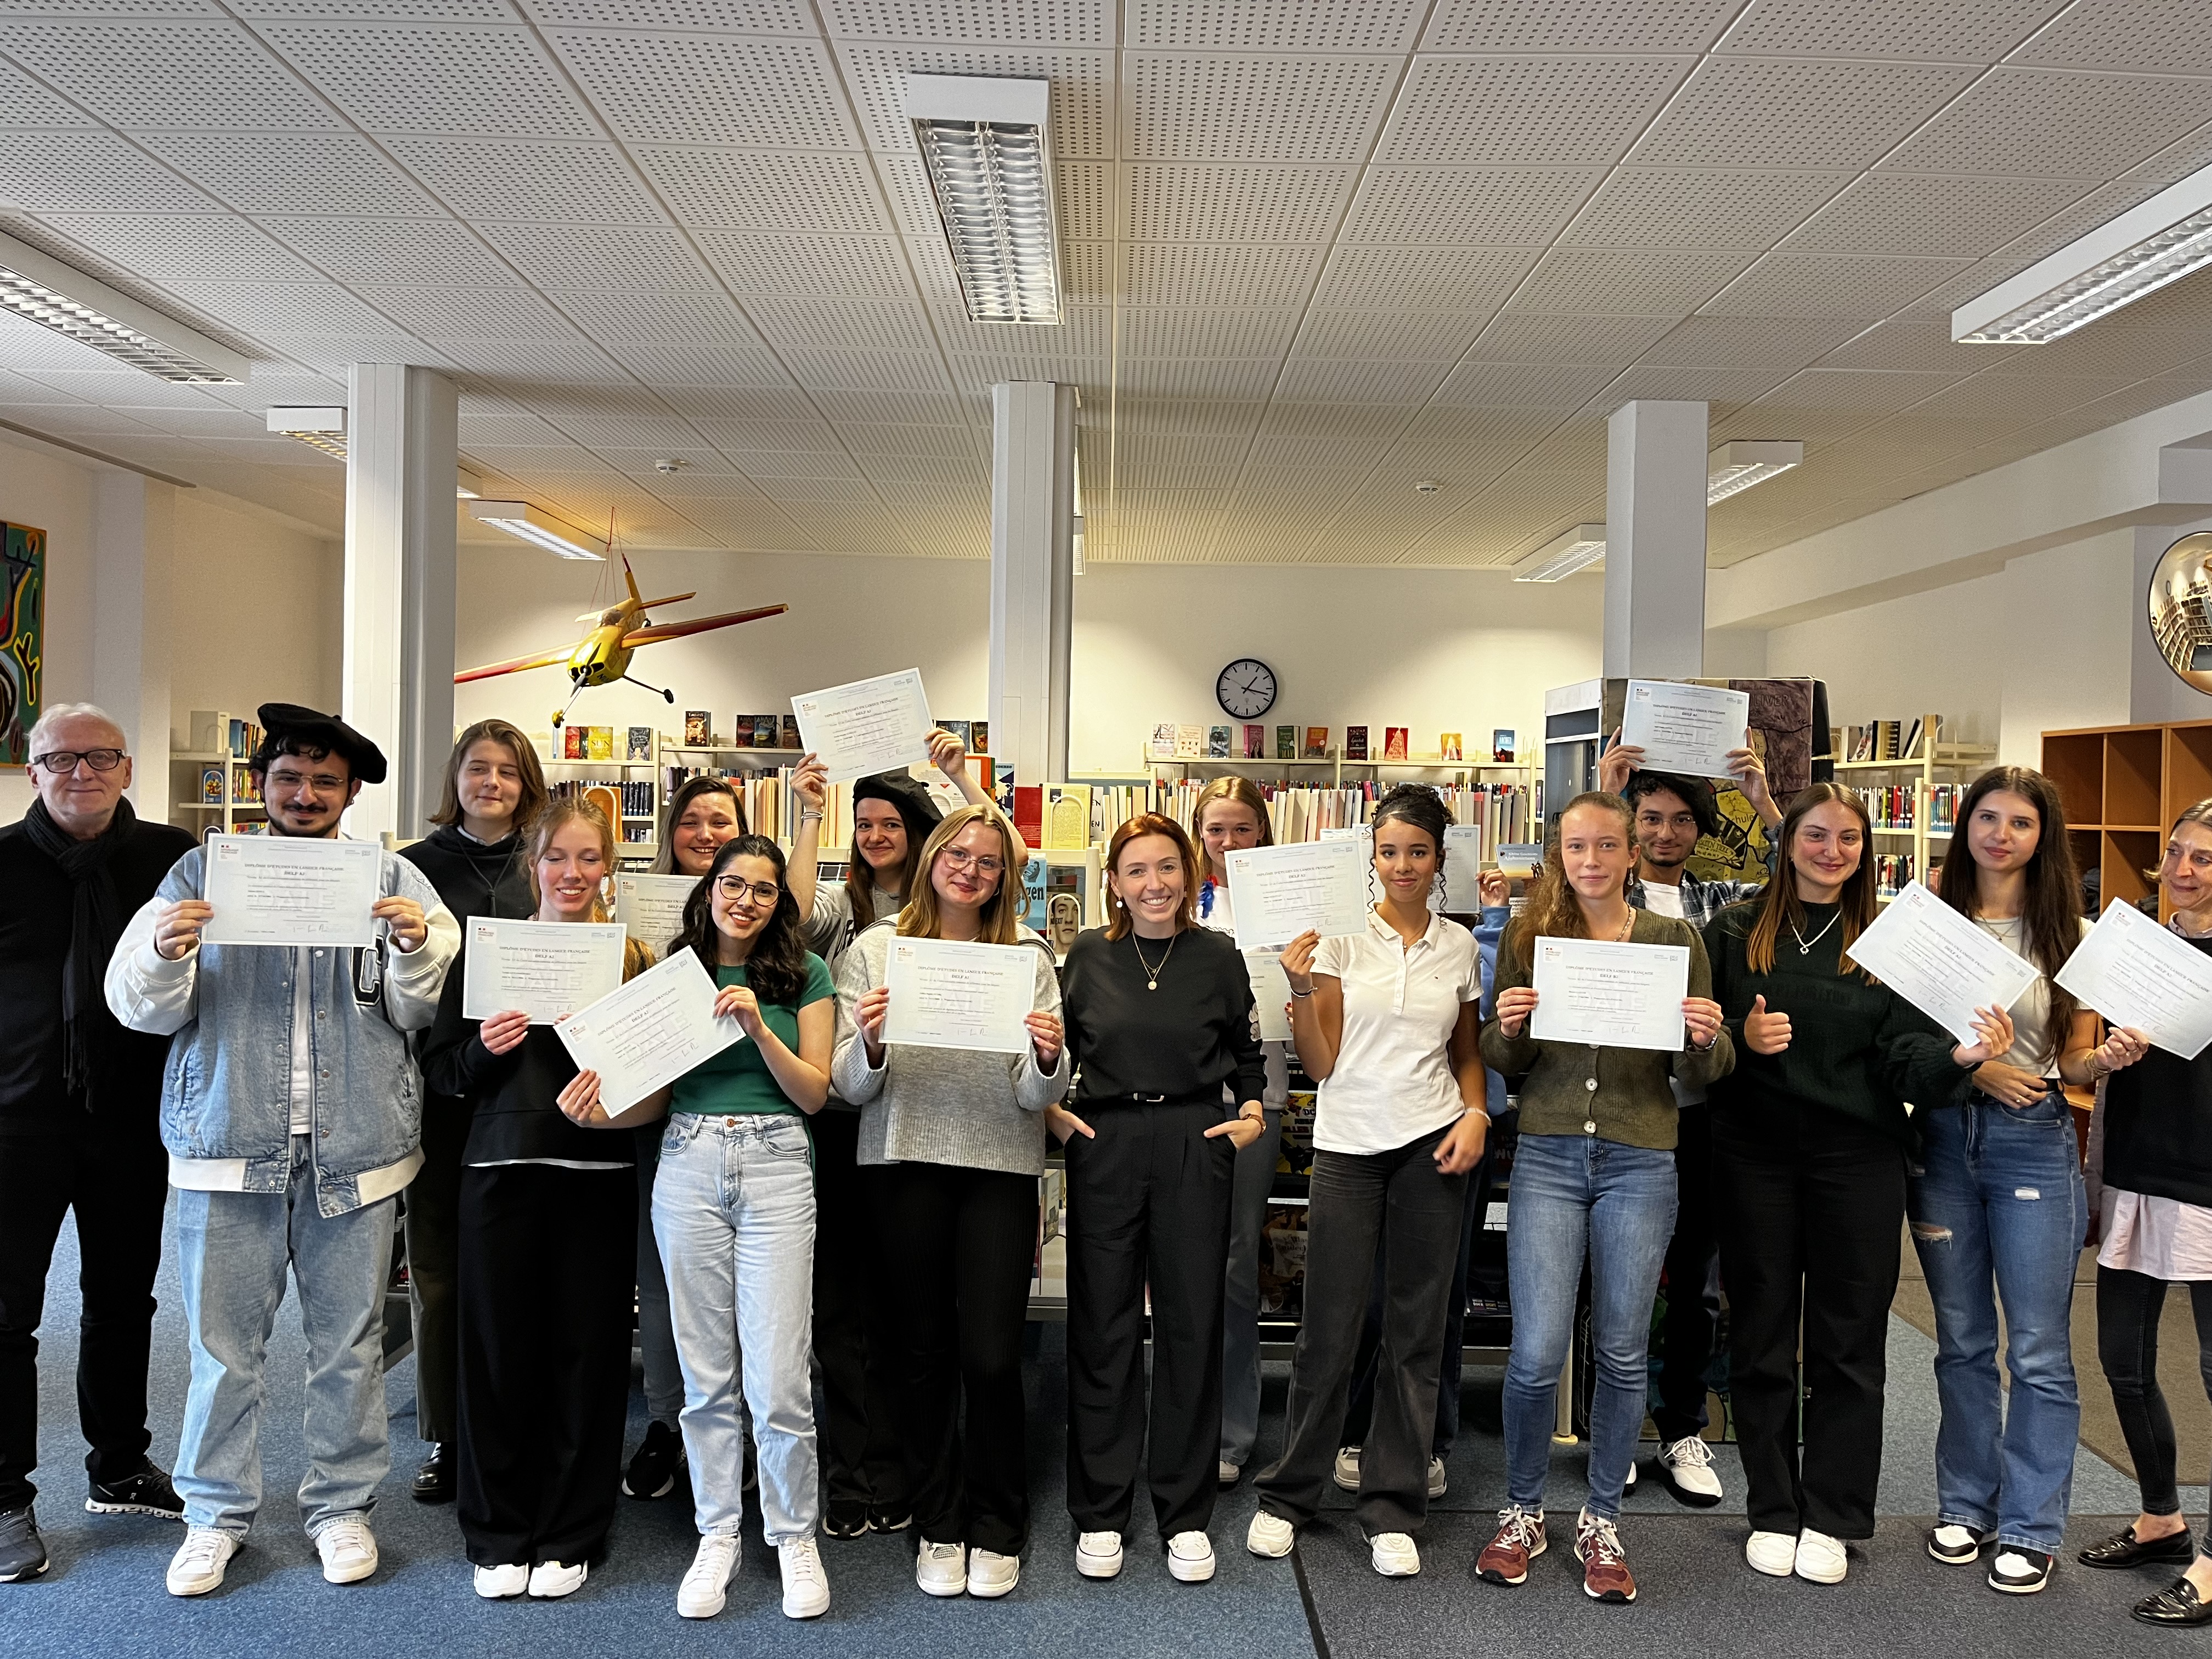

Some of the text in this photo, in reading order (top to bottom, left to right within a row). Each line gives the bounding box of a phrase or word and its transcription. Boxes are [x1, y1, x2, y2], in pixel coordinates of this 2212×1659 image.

[1750, 694, 1789, 707] LIVER
[350, 934, 384, 1007] C
[640, 1000, 656, 1011] LANGUE
[656, 988, 676, 1002] FRANÇAISE
[631, 1012, 645, 1023] DELF
